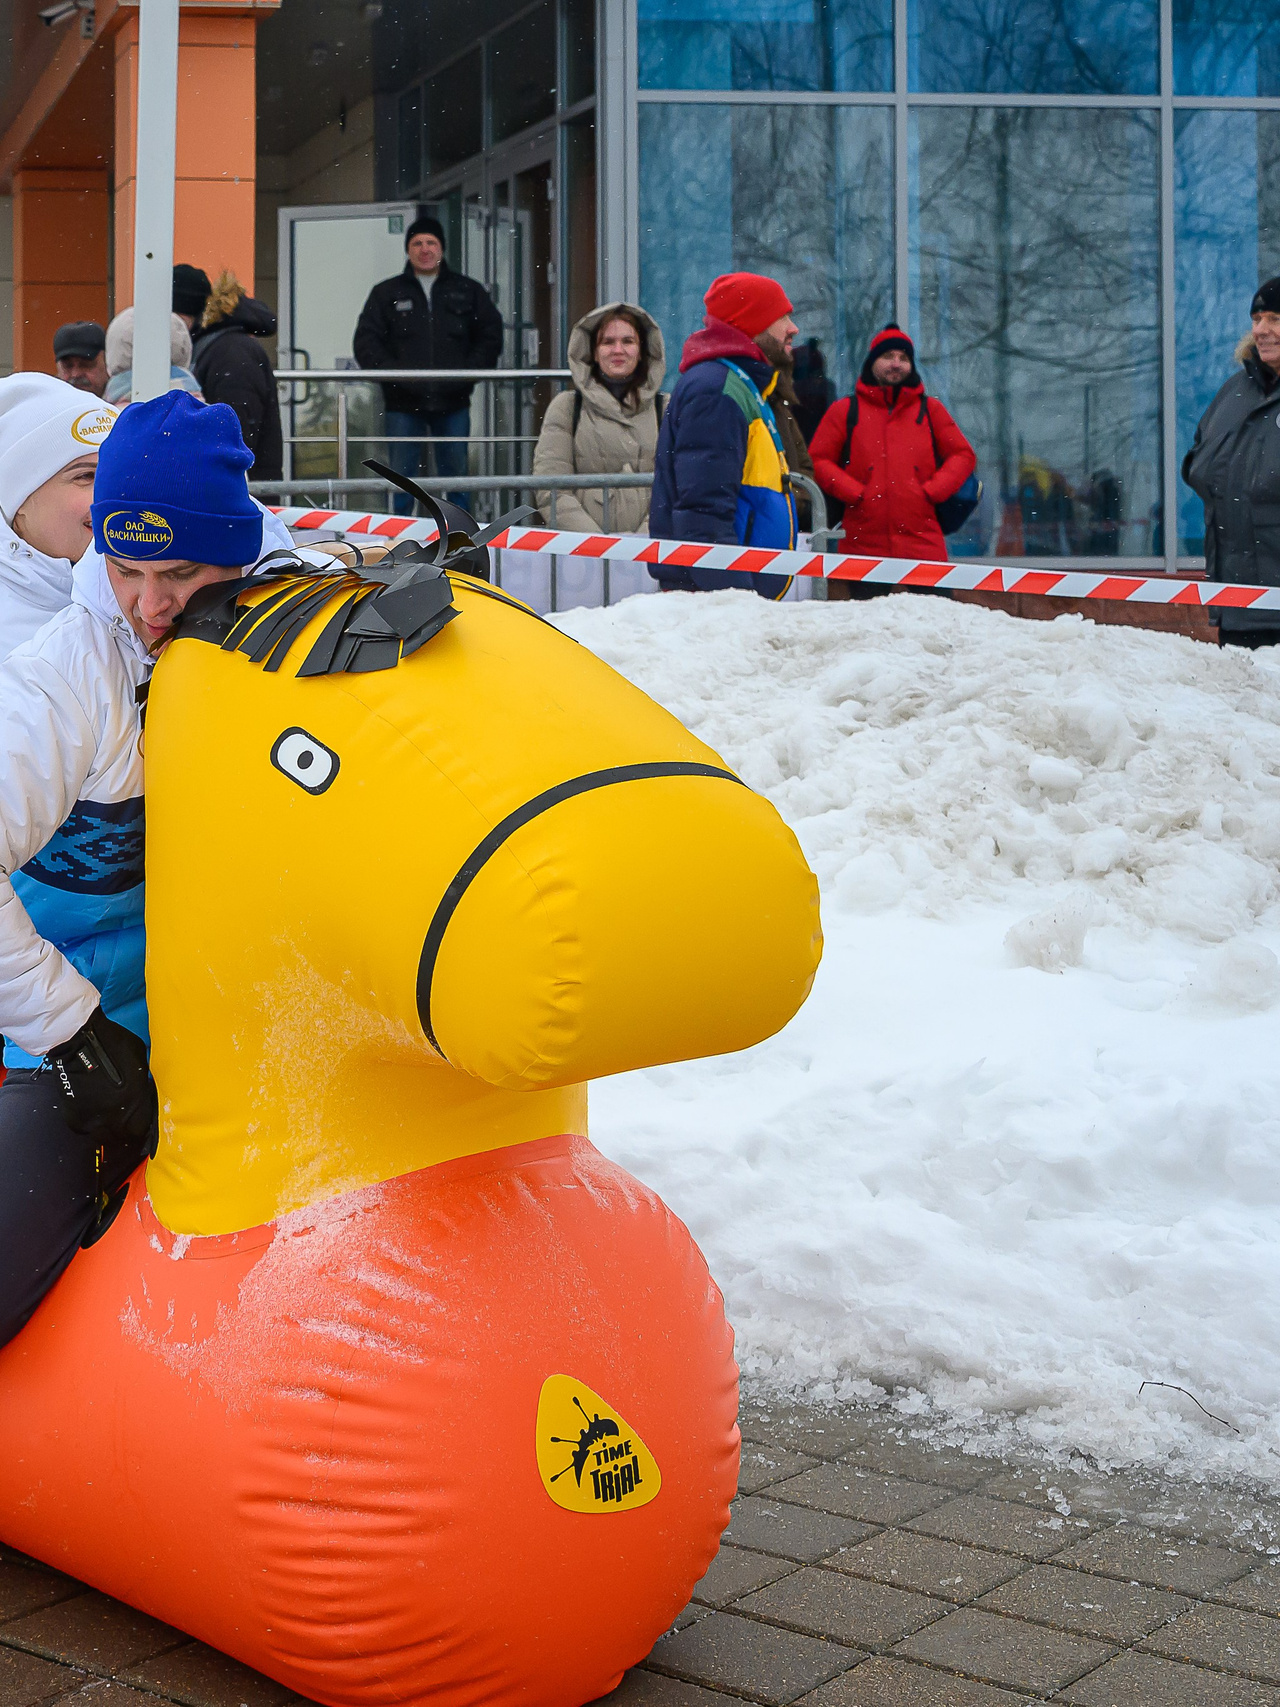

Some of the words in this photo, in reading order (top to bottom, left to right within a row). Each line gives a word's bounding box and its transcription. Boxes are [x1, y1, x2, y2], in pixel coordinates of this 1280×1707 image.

[95, 416, 112, 425] ОАО
[125, 520, 145, 532] ОАО
[55, 1058, 75, 1099] SPORT
